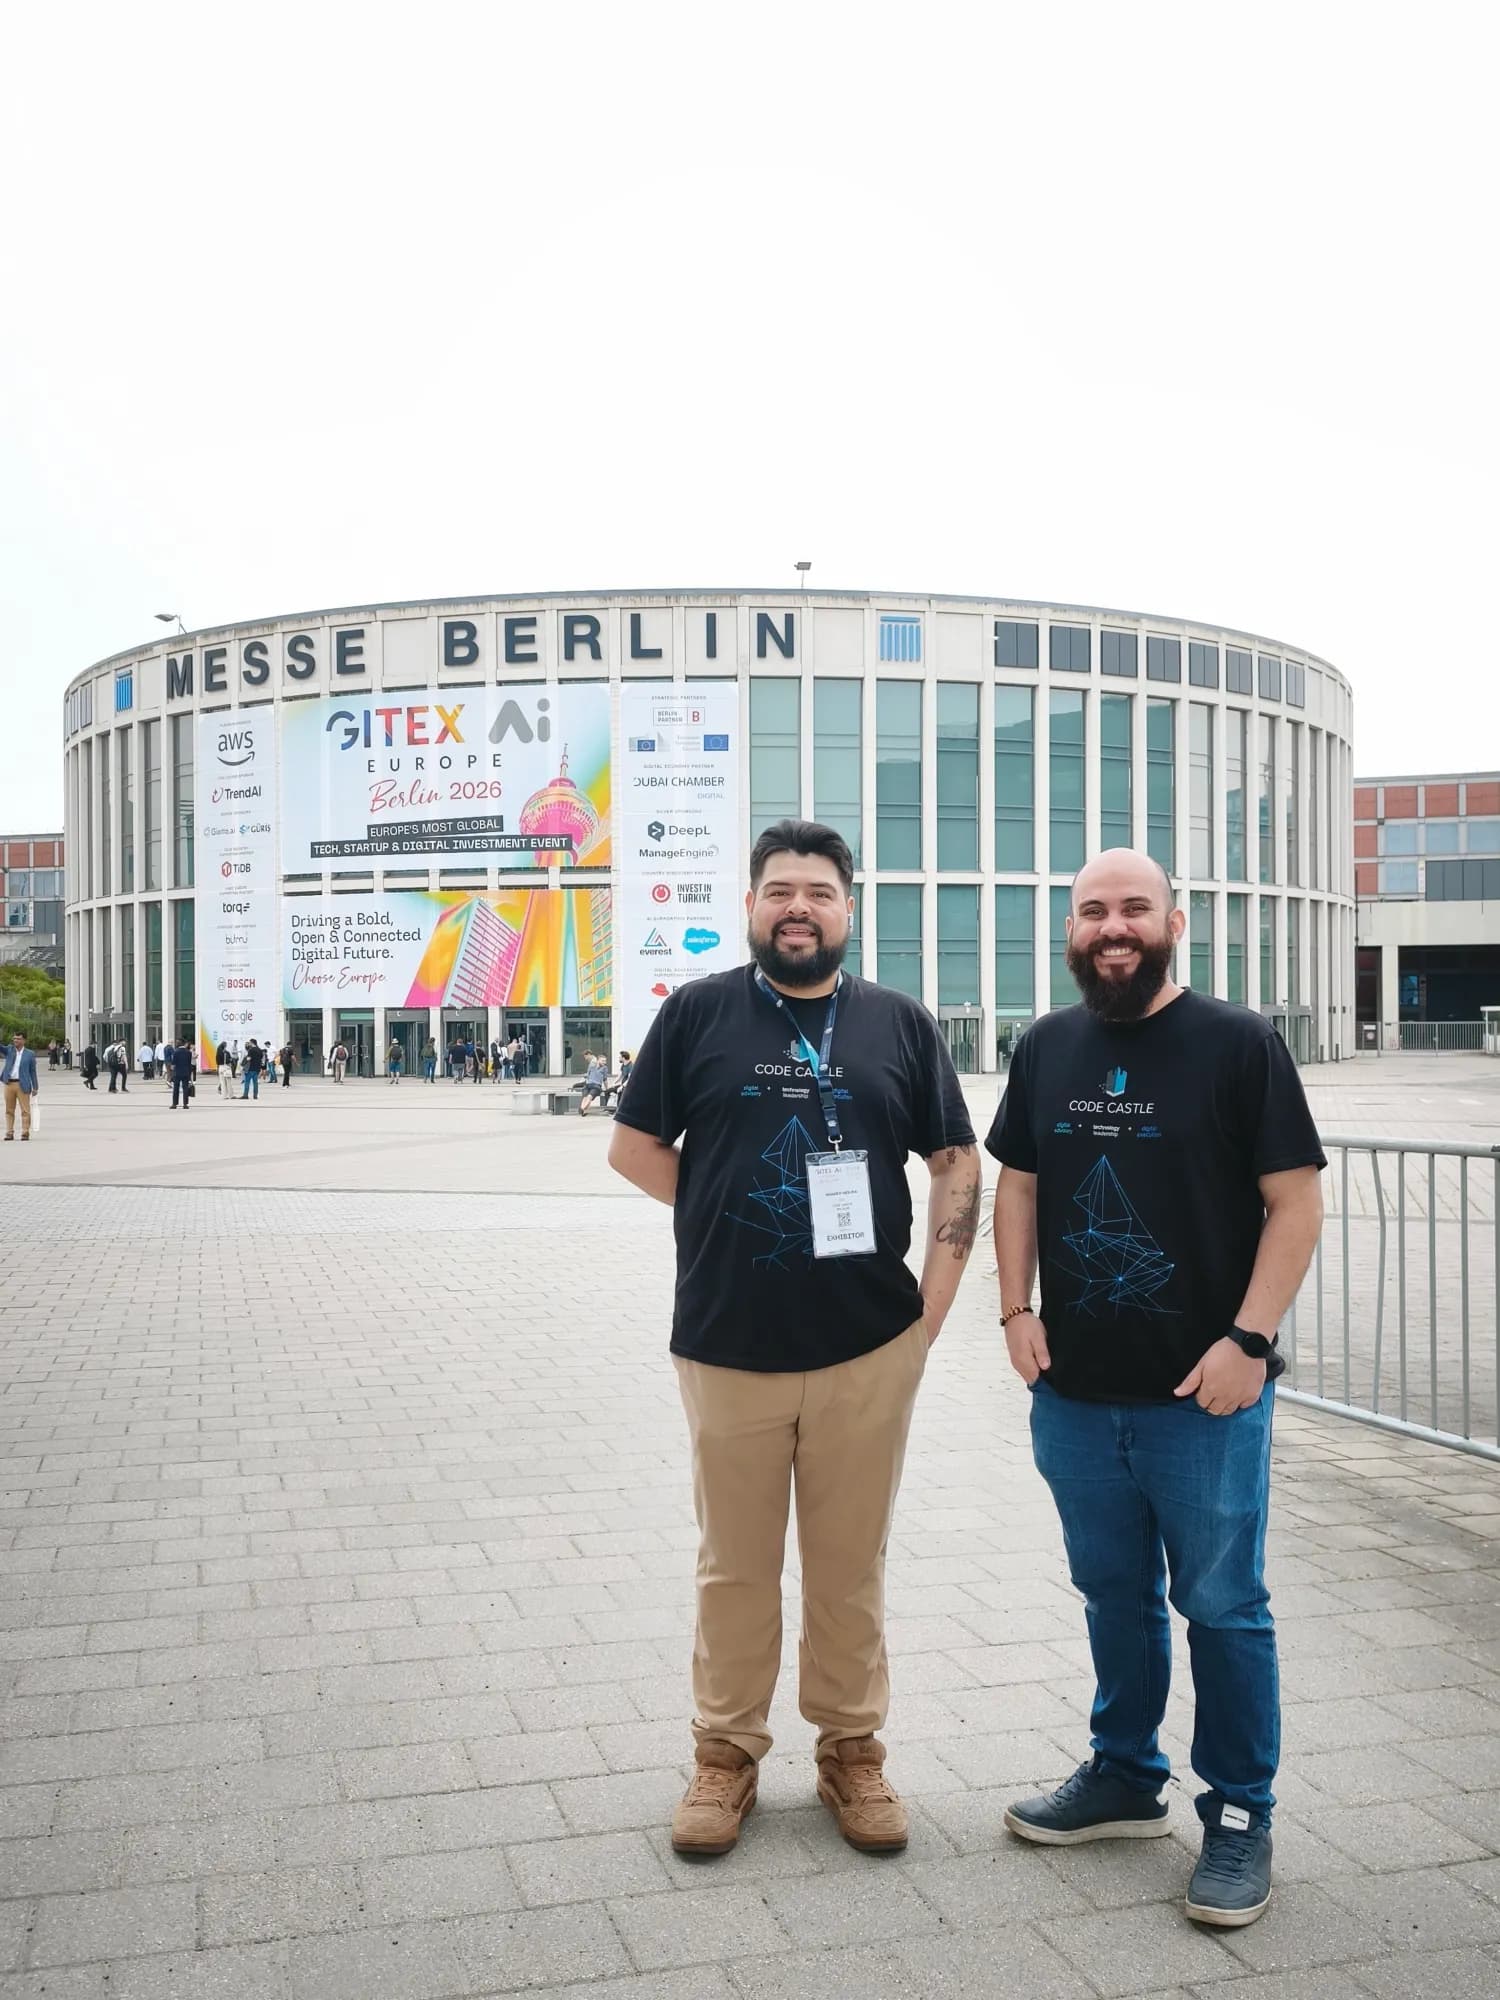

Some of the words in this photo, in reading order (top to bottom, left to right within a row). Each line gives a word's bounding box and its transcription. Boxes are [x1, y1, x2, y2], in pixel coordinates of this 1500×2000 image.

[167, 628, 366, 699] MESSE
[443, 612, 795, 667] BERLIN
[692, 710, 700, 722] B
[326, 704, 465, 750] GITEX
[218, 730, 254, 752] aws
[367, 753, 502, 772] EUROPE
[671, 776, 725, 787] CHAMBER
[368, 778, 443, 814] Berlin
[449, 780, 502, 801] 2026
[370, 825, 419, 838] EUROPE'S
[421, 821, 454, 834] MOST
[456, 816, 501, 831] GLOBAL
[668, 825, 711, 838] DeepL
[313, 844, 342, 856] TECH,
[343, 840, 390, 854] STARTUP
[402, 840, 450, 852] DIGITAL
[452, 837, 527, 850] INVESTMENT
[530, 837, 569, 847] EVENT
[639, 848, 714, 859] ManageEngine
[677, 883, 702, 893] INVEST
[703, 883, 712, 893] IN
[291, 914, 341, 930] Driving
[344, 916, 352, 925] a
[357, 911, 394, 926] Bold,
[291, 931, 325, 947] Open
[329, 930, 339, 943] &
[343, 927, 422, 943] Connected
[292, 946, 340, 964] Digital
[343, 946, 394, 959] Future.
[639, 948, 672, 956] everest
[227, 978, 256, 988] BOSCH
[292, 963, 335, 990] Choose
[337, 966, 385, 993] Europe
[221, 1009, 253, 1025] Google
[754, 1063, 792, 1077] CODE
[794, 1066, 844, 1077] CALE
[1069, 1100, 1104, 1113] CODE
[1107, 1102, 1155, 1114] CASTLE
